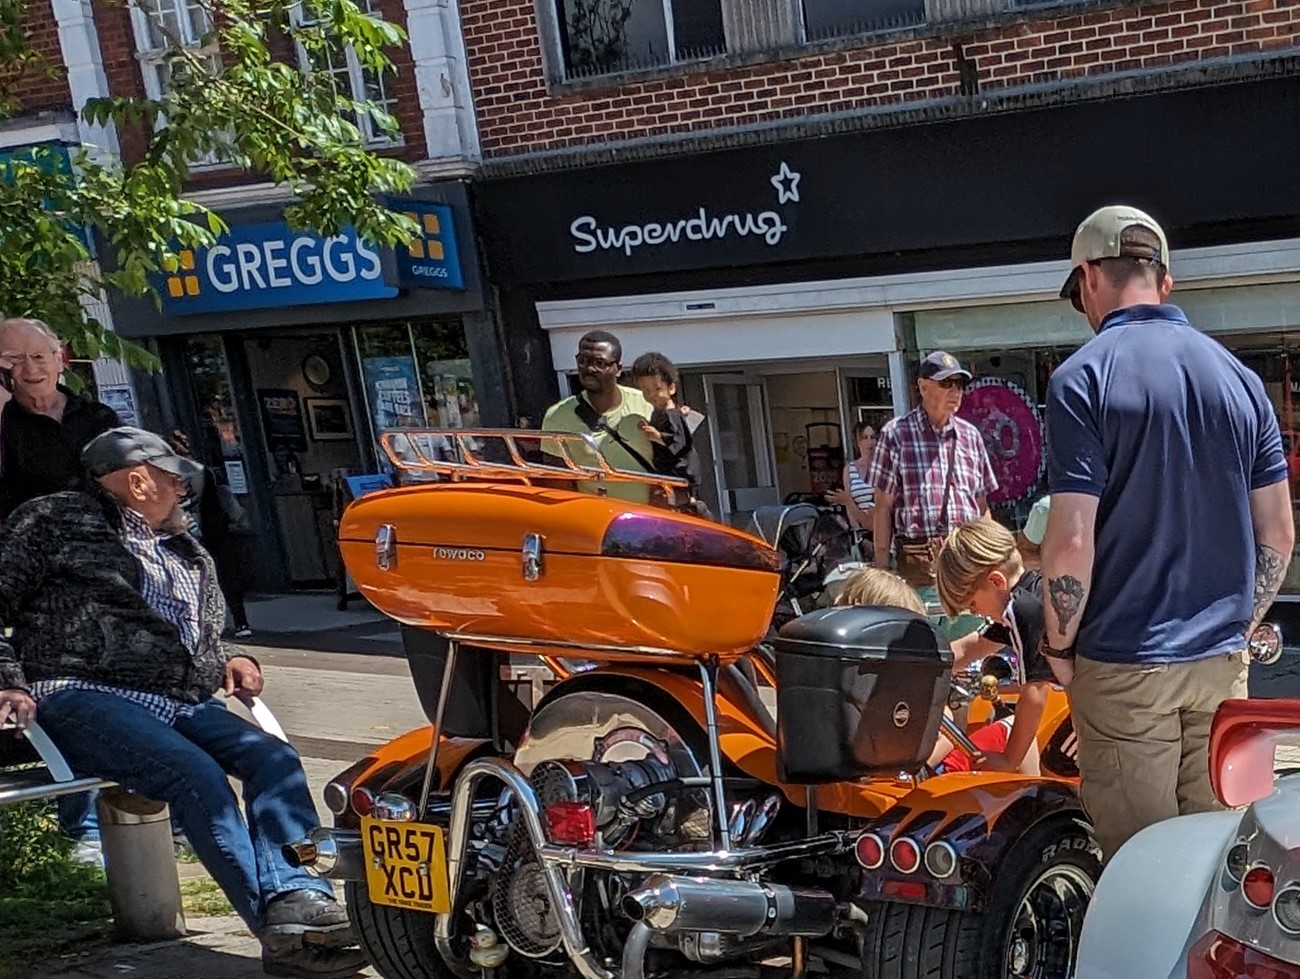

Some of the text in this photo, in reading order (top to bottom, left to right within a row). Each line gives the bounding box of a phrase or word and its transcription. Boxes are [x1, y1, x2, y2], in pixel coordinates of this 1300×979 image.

[570, 207, 787, 256] Superdrug
[206, 234, 381, 293] GREGGS
[412, 265, 448, 278] GREGGS
[368, 824, 436, 863] GR57
[381, 863, 434, 902] XCD
